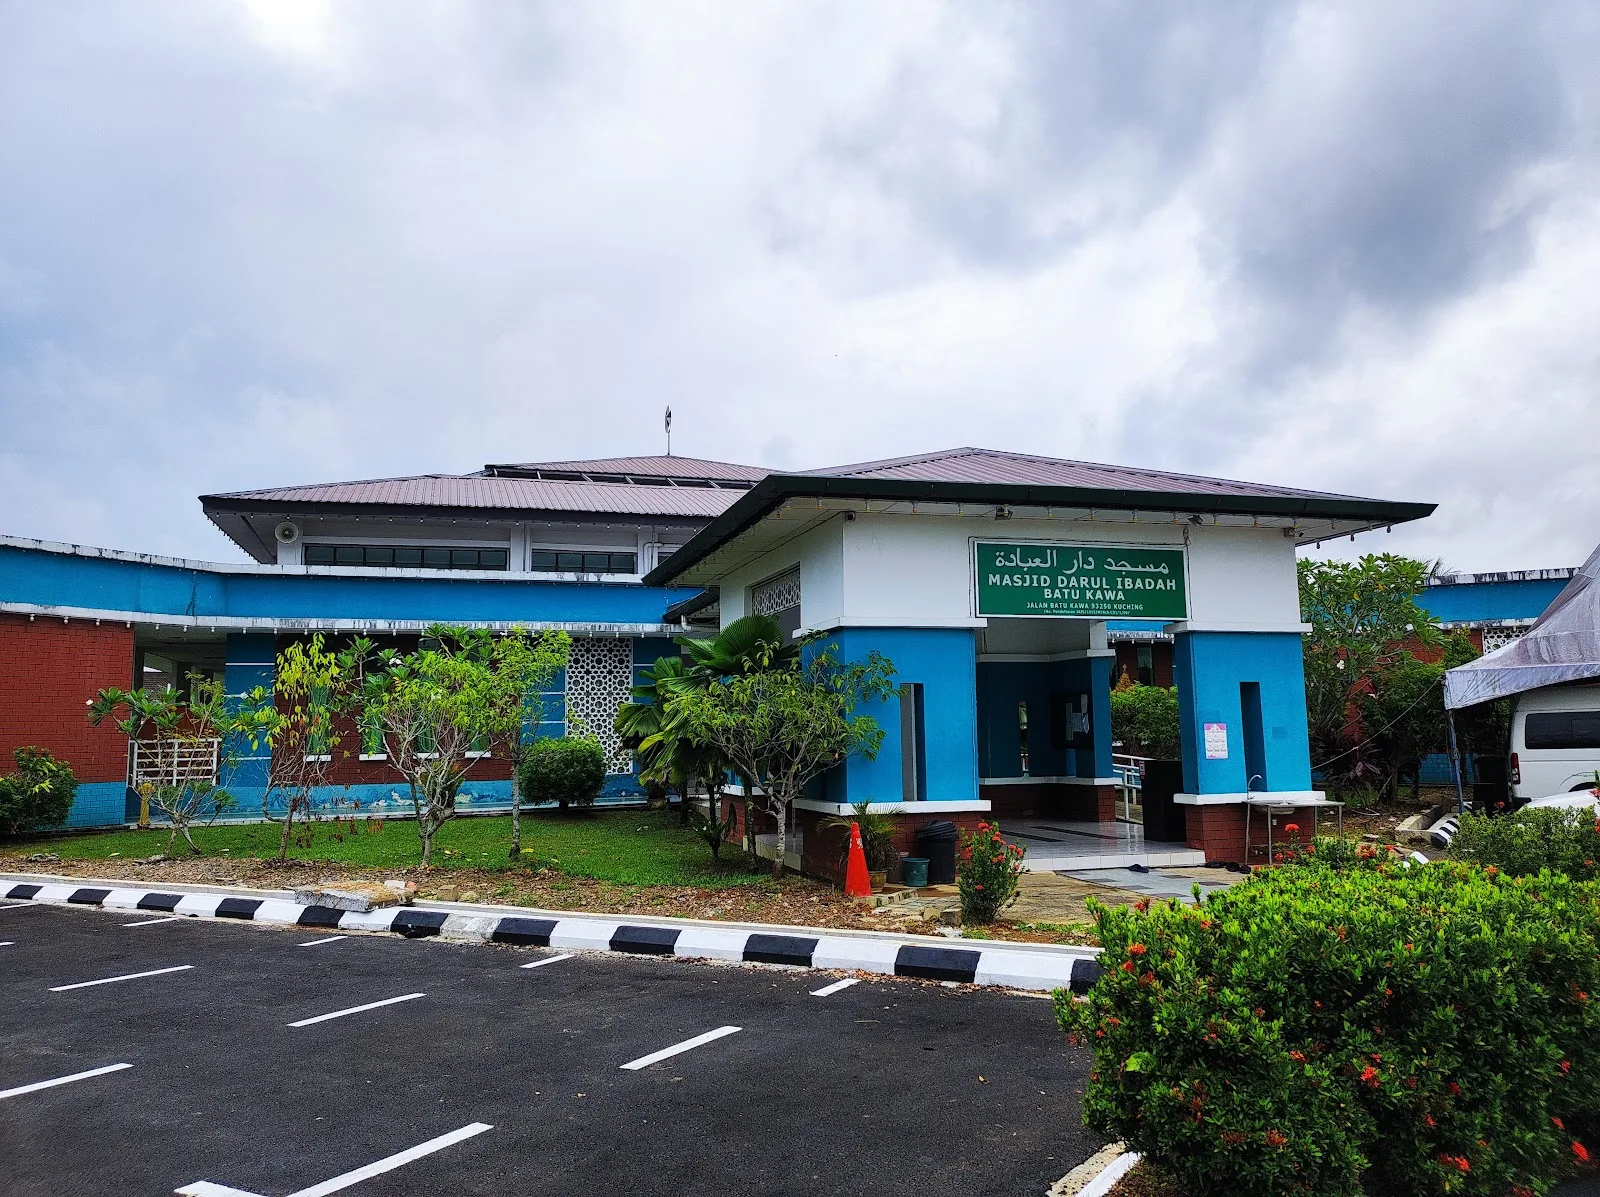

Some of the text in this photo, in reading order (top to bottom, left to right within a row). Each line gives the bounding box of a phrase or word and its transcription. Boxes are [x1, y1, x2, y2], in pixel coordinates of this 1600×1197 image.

[995, 547, 1169, 575] مسجد دار العبادة
[988, 573, 1176, 590] MASJID DARUL IBADAH
[1044, 588, 1125, 601] BATU KAWA
